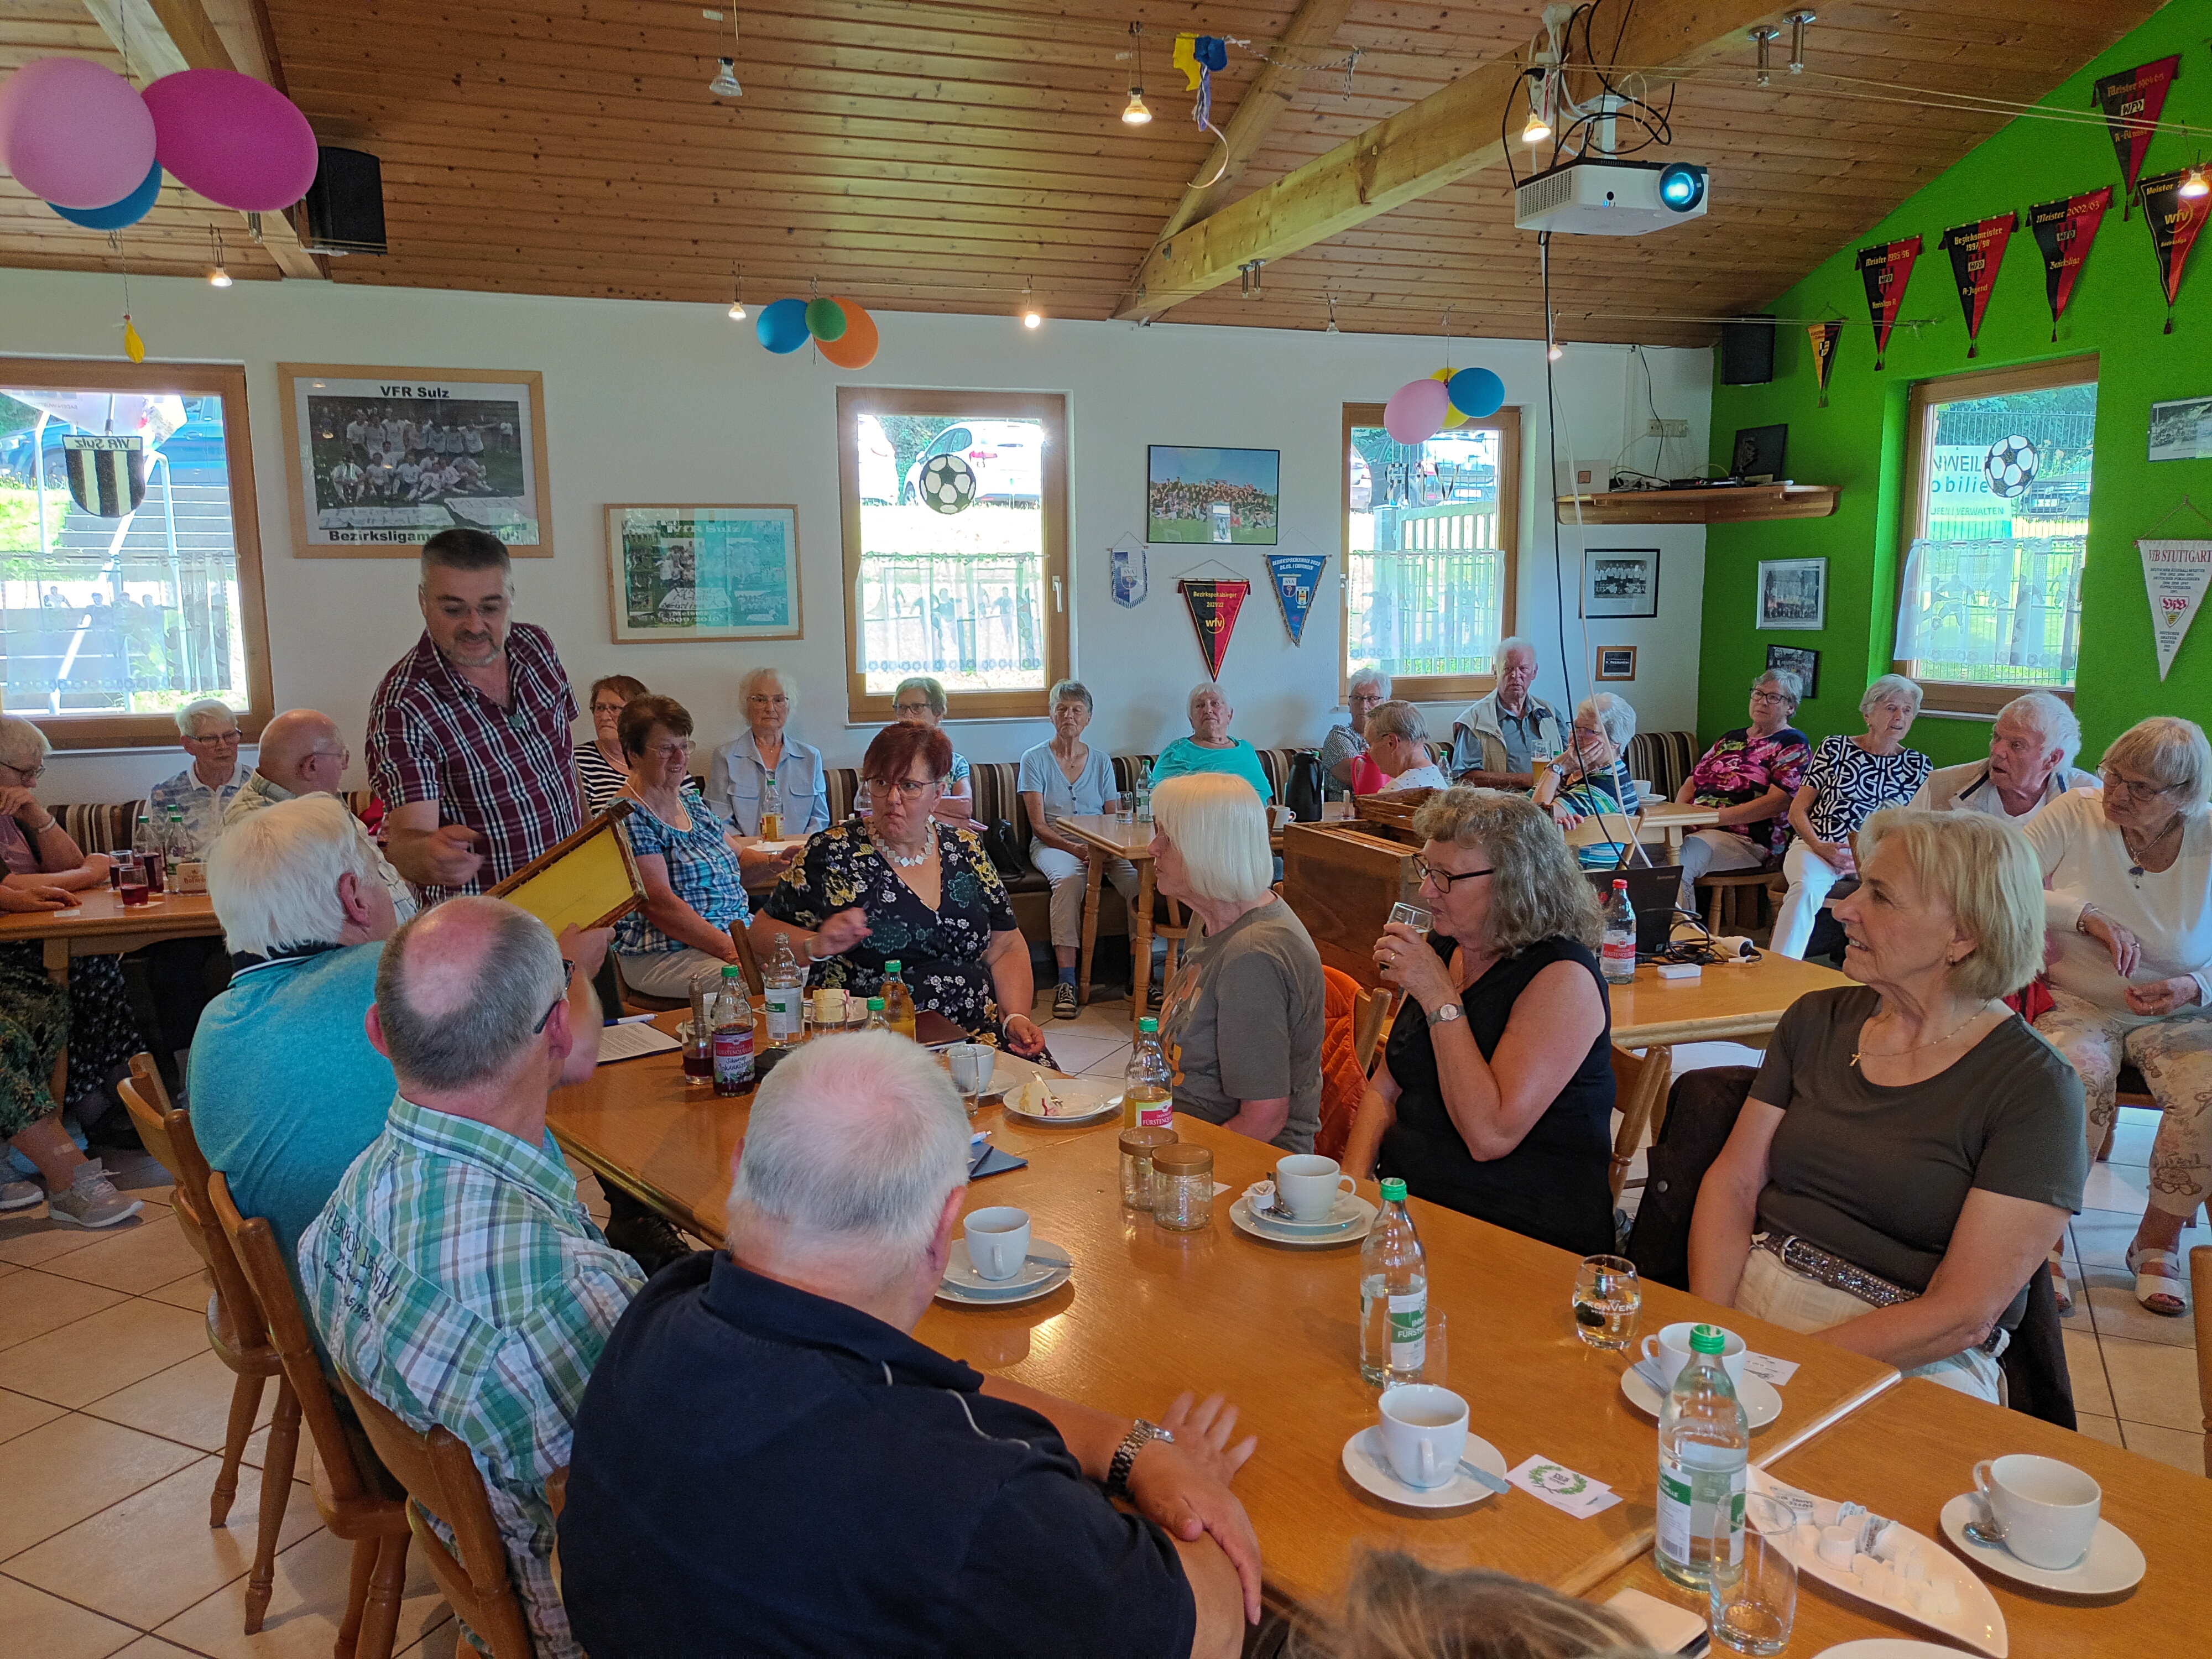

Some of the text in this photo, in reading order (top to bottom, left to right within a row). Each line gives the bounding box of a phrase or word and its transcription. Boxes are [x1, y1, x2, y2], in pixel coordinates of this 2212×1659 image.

[2147, 184, 2173, 195] Meister
[2036, 200, 2100, 223] Meister 2002/03
[2164, 209, 2189, 225] wfv
[1954, 227, 2002, 246] Bezirksmeister
[1966, 239, 1990, 251] 1997/98
[1866, 249, 1910, 267] Meister 1995/96
[2049, 257, 2079, 270] Bezirksliga
[1963, 284, 1987, 296] A-Jugend
[380, 385, 450, 398] VFR Sulz
[1957, 507, 2004, 515] VERWALTEN
[2162, 549, 2212, 562] STUTTGART
[1205, 617, 1223, 627] wfv
